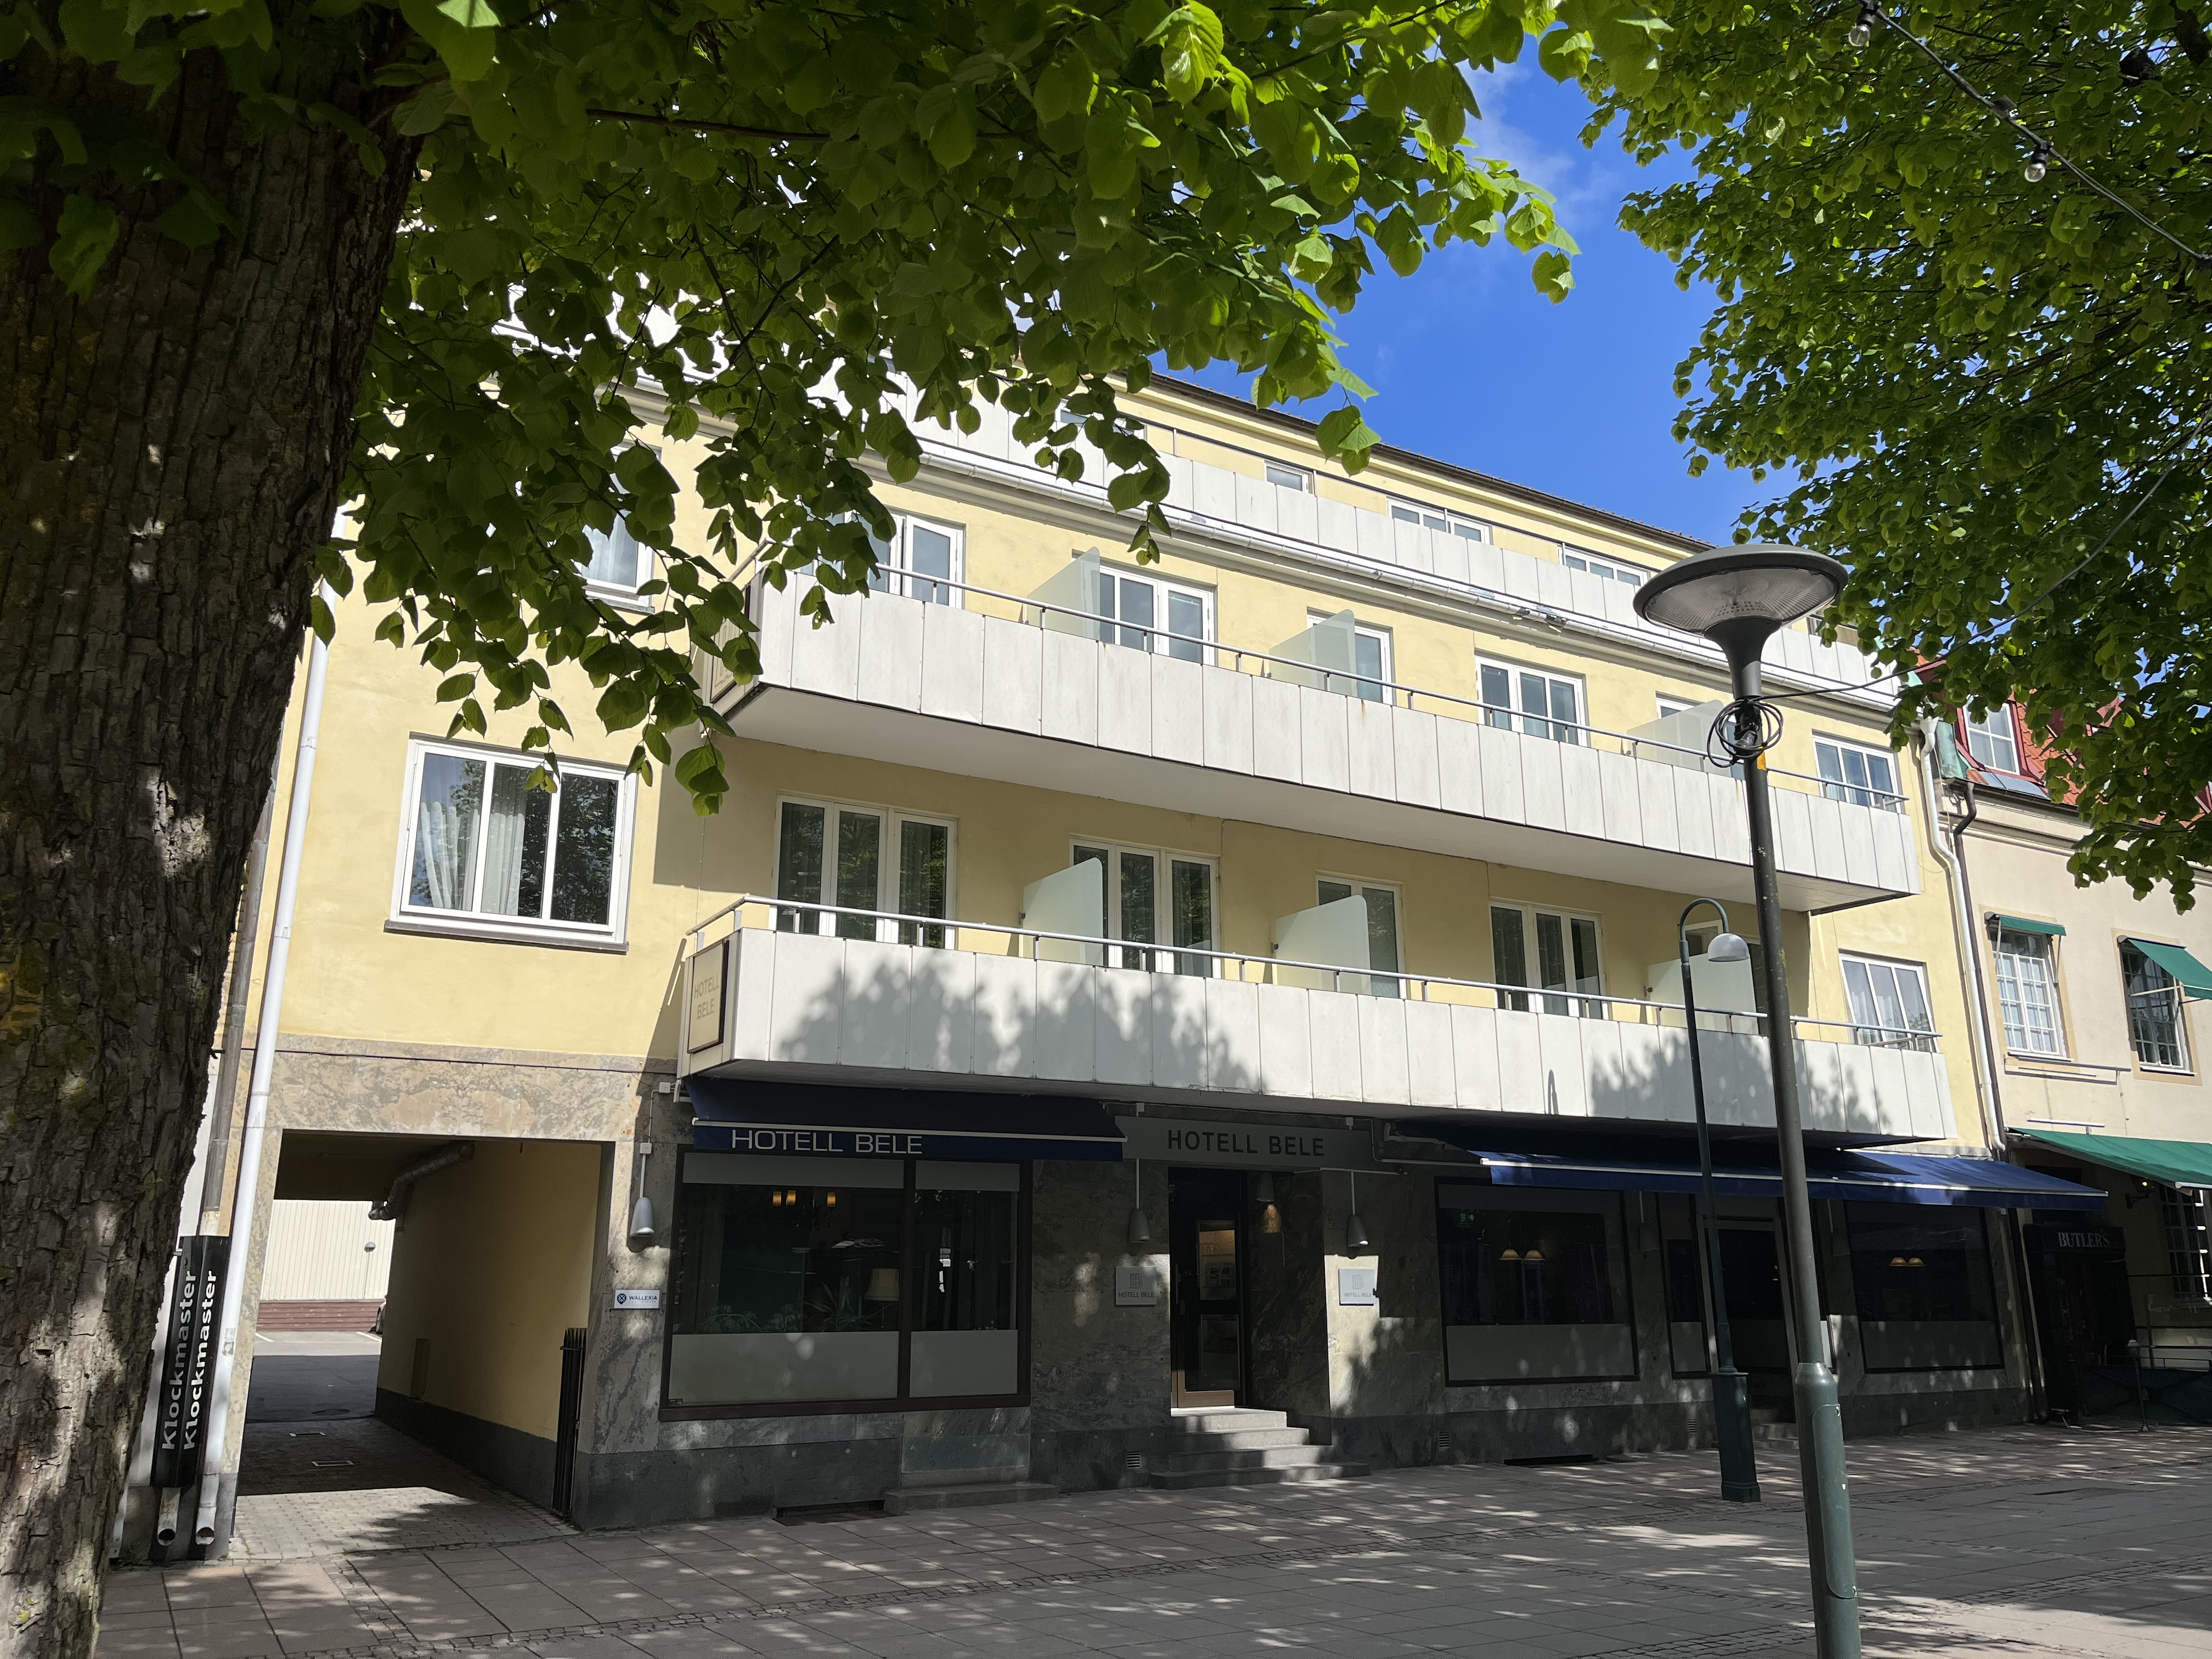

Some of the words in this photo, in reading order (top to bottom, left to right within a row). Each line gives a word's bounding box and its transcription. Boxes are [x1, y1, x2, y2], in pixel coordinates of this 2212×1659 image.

[693, 973, 720, 999] HOTELL
[697, 998, 715, 1020] BELE
[732, 1129, 843, 1153] HOTELL
[855, 1133, 923, 1154] BELE
[1168, 1130, 1258, 1154] HOTELL
[1269, 1135, 1325, 1156] BELE
[161, 1270, 196, 1449] Klockmaster
[183, 1270, 217, 1450] Klockmaster
